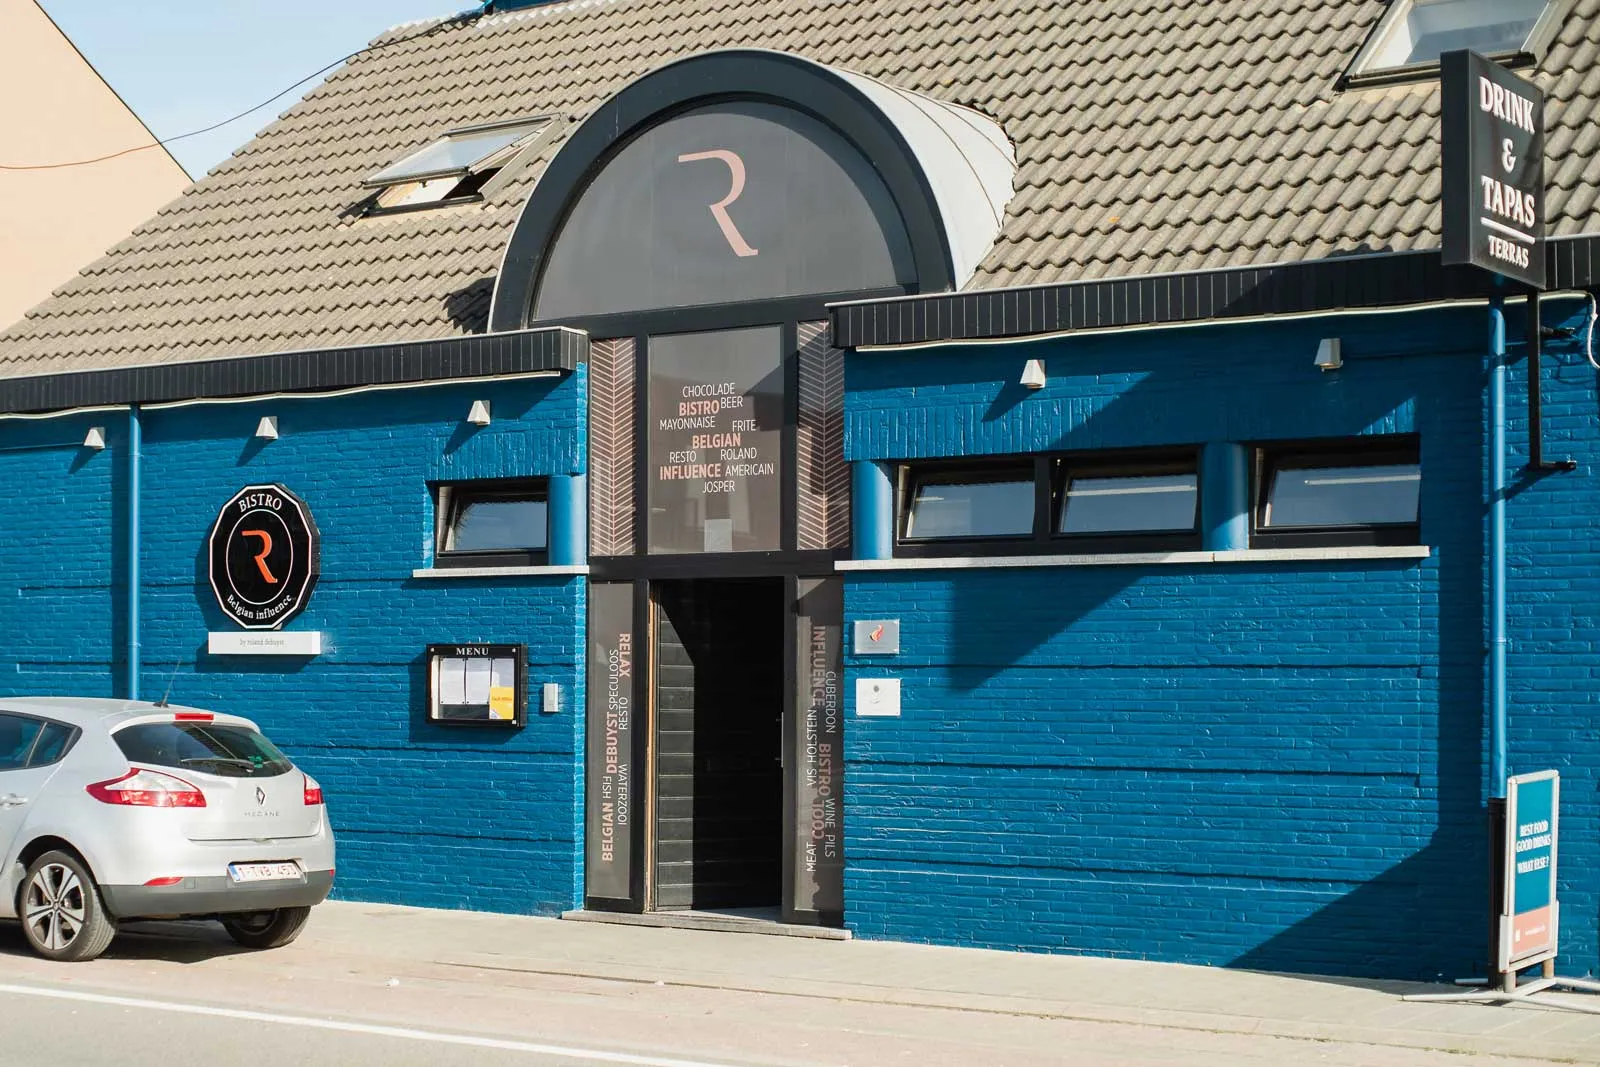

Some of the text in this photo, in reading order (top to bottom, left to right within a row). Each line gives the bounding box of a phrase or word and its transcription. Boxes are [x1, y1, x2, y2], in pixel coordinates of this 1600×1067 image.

[1479, 76, 1535, 134] DRINK
[1502, 138, 1516, 173] &
[679, 150, 758, 256] R
[1481, 175, 1535, 228] TAPAS
[1488, 235, 1529, 269] TERRAS
[683, 383, 735, 397] CHOCOLADE
[721, 396, 743, 409] BEER
[660, 416, 715, 430] MAYONNAISE
[680, 400, 719, 416] BISTRO
[692, 433, 740, 449] BELGIAN
[732, 420, 756, 432] FRITE
[670, 450, 696, 463] RESTO
[721, 447, 757, 460] ROLAND
[660, 463, 774, 480] INFLUENCE AMERICAIN
[703, 480, 735, 493] JOSPER
[238, 493, 282, 512] BISTRO
[242, 530, 278, 583] R
[227, 594, 292, 620] Belgian influence
[456, 647, 489, 655] MENU
[619, 634, 631, 677] RELAX
[813, 626, 826, 706] INFLUENCE
[609, 649, 618, 710] SPECULOOS
[619, 697, 628, 730] RESTO
[826, 671, 837, 733] CUBERDON
[606, 712, 618, 774] DEBUYST
[806, 710, 818, 786] VIS HOLSTEIN
[819, 743, 831, 796] BISTRO
[602, 776, 612, 799] FISH
[617, 764, 628, 825] WATERZOOI
[602, 802, 613, 861] BELGIAN
[812, 799, 825, 840] COOL
[825, 798, 836, 857] WINE PILS
[1520, 820, 1548, 837] BEST FOOD
[806, 842, 817, 871] MEAT
[1516, 838, 1532, 852] GOOD
[1518, 860, 1533, 873] WHAT
